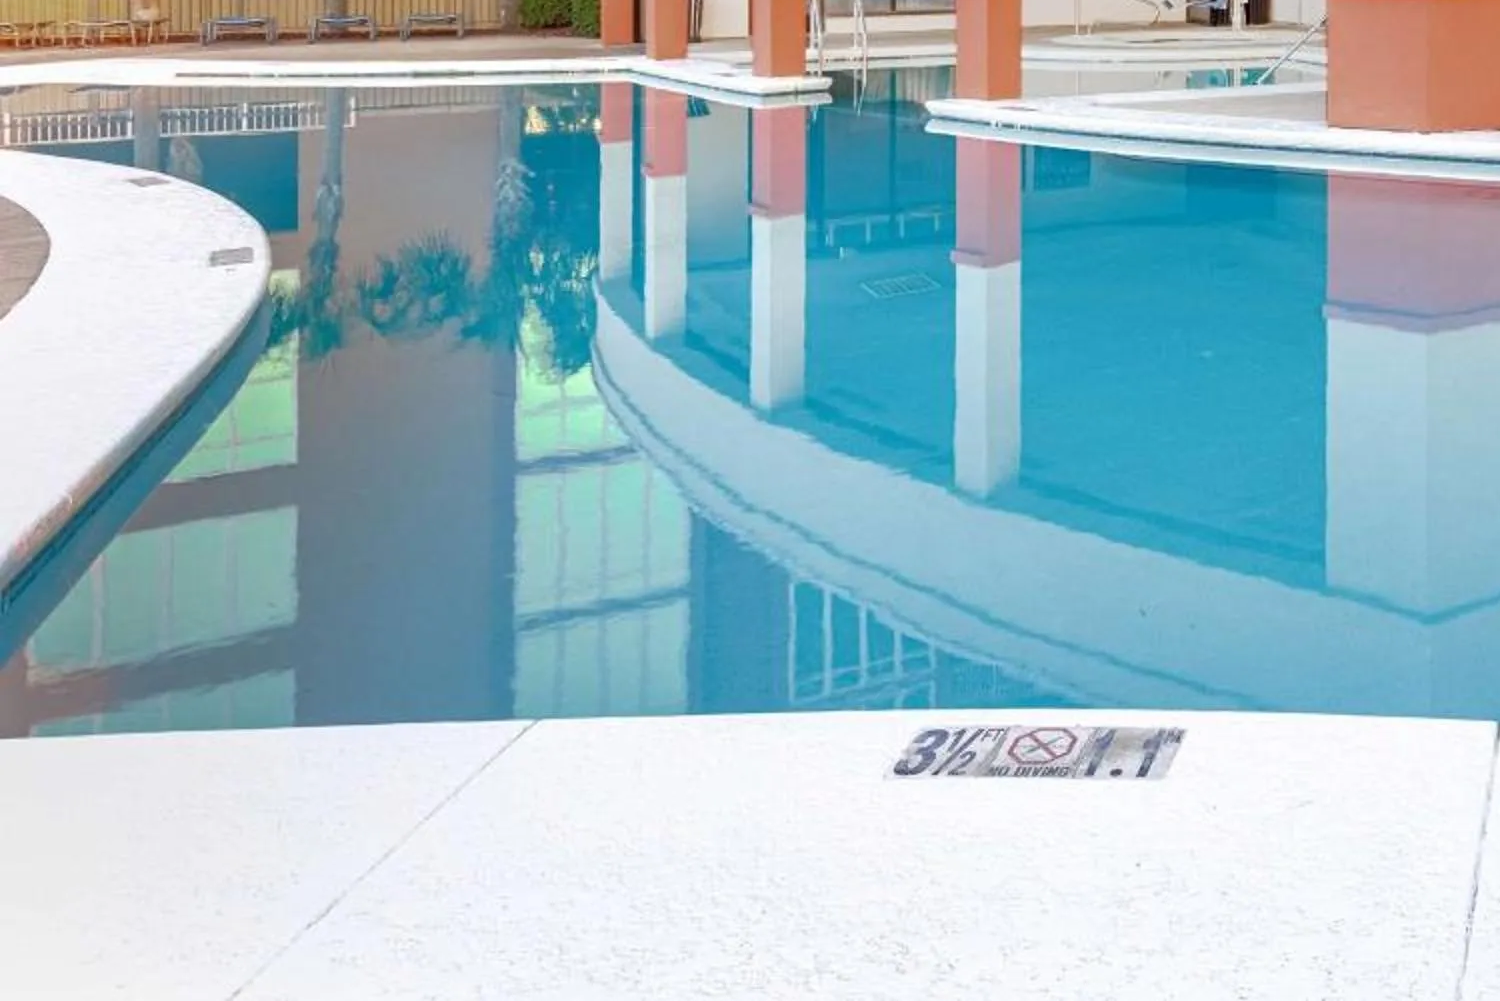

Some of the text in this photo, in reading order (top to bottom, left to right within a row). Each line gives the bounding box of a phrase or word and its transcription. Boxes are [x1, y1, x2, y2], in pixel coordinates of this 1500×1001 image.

[981, 728, 1005, 742] FT
[989, 766, 1070, 777] NO DIVING
